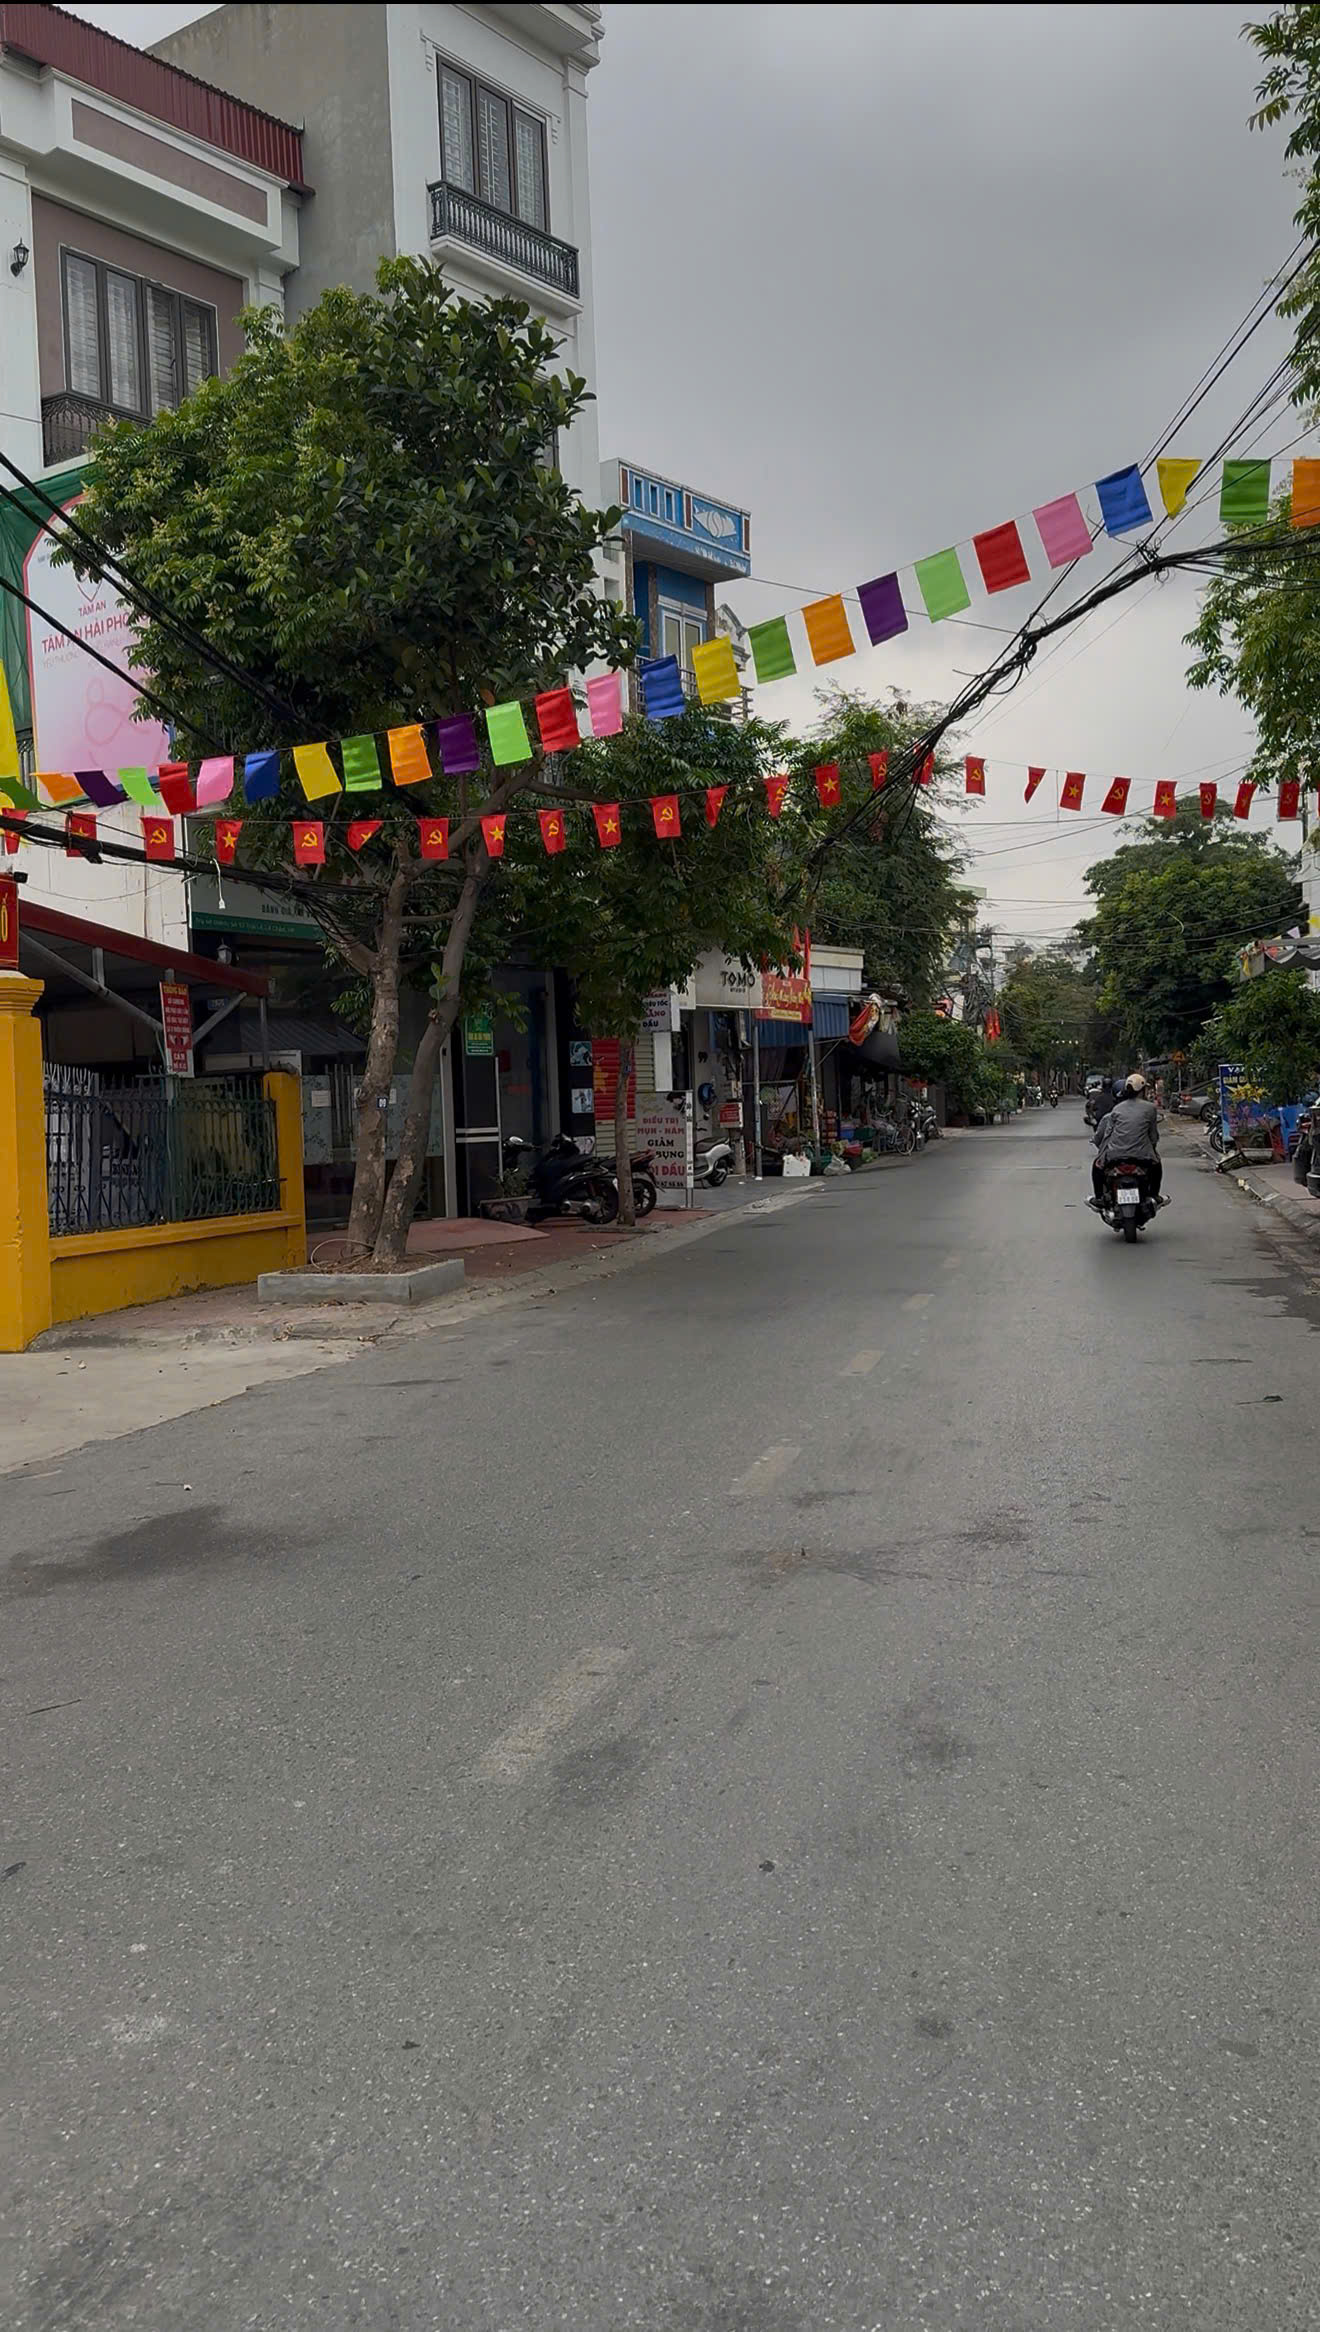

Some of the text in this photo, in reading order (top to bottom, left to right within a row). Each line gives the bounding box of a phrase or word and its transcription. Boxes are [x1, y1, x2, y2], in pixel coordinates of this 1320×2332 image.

[96, 600, 107, 611] AN
[42, 633, 64, 654] TÂM
[85, 617, 104, 640] HẢI
[648, 1137, 674, 1147] GIẢM
